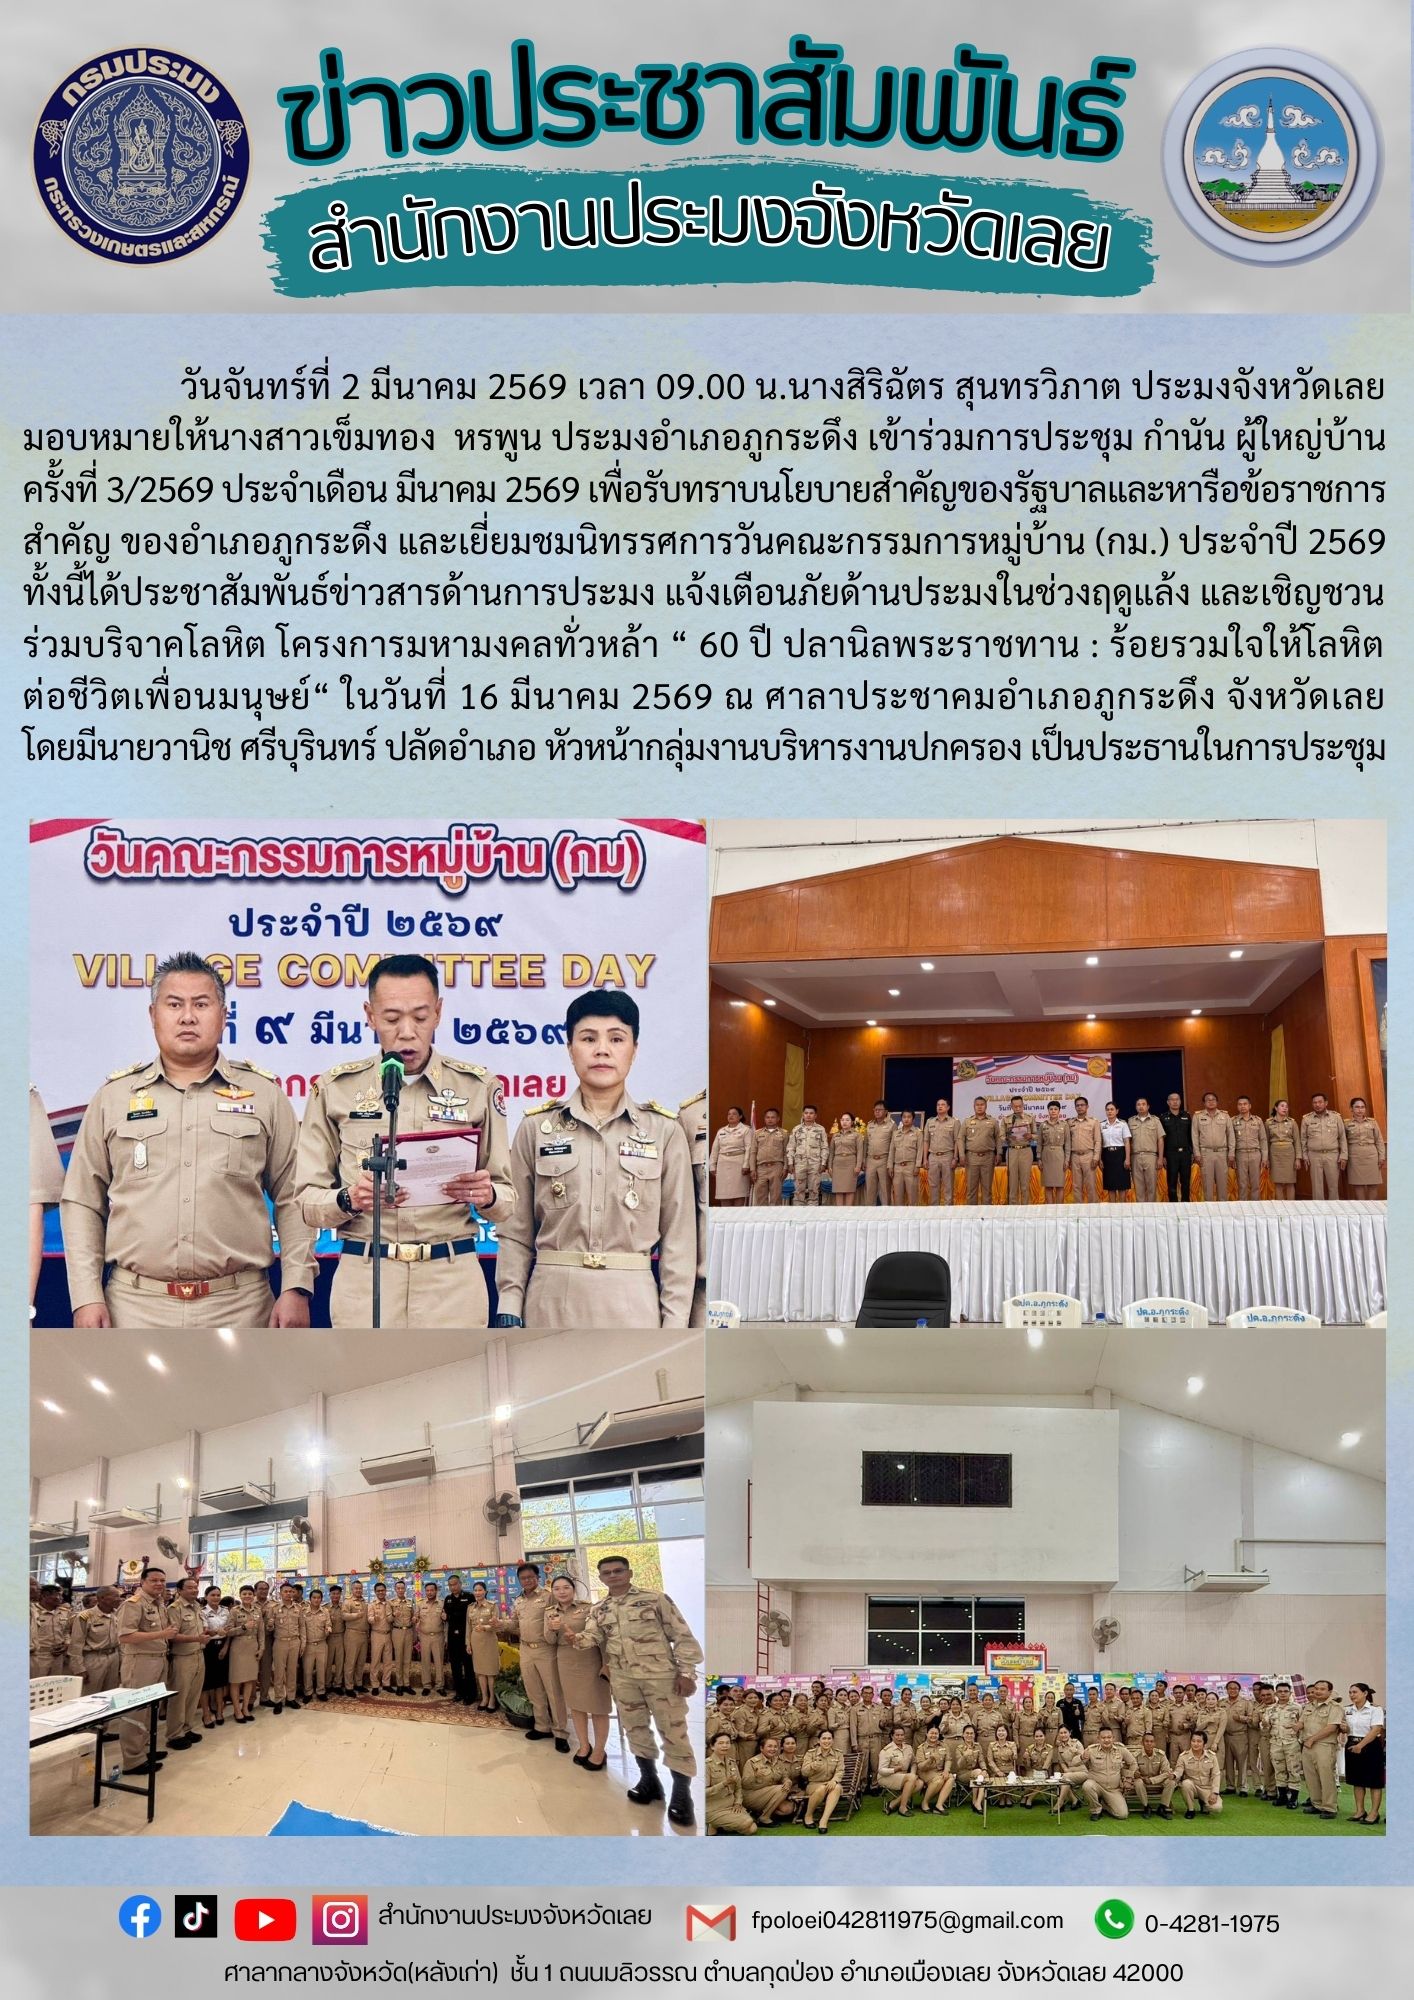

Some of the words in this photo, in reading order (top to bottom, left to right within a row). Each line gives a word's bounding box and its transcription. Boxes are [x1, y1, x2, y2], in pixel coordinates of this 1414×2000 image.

[87, 826, 545, 892] วันคณะกรรมการหมู่บ้าน
[553, 833, 643, 886] (กม)
[228, 904, 370, 937] ประจำปี
[385, 907, 504, 937] ๒๕๖๙
[73, 953, 262, 988] VILLGE
[277, 953, 553, 988] COMTTEE
[563, 953, 656, 988] DAY
[255, 1012, 295, 1045] ๙
[453, 1017, 568, 1045] ๒๕๖๙
